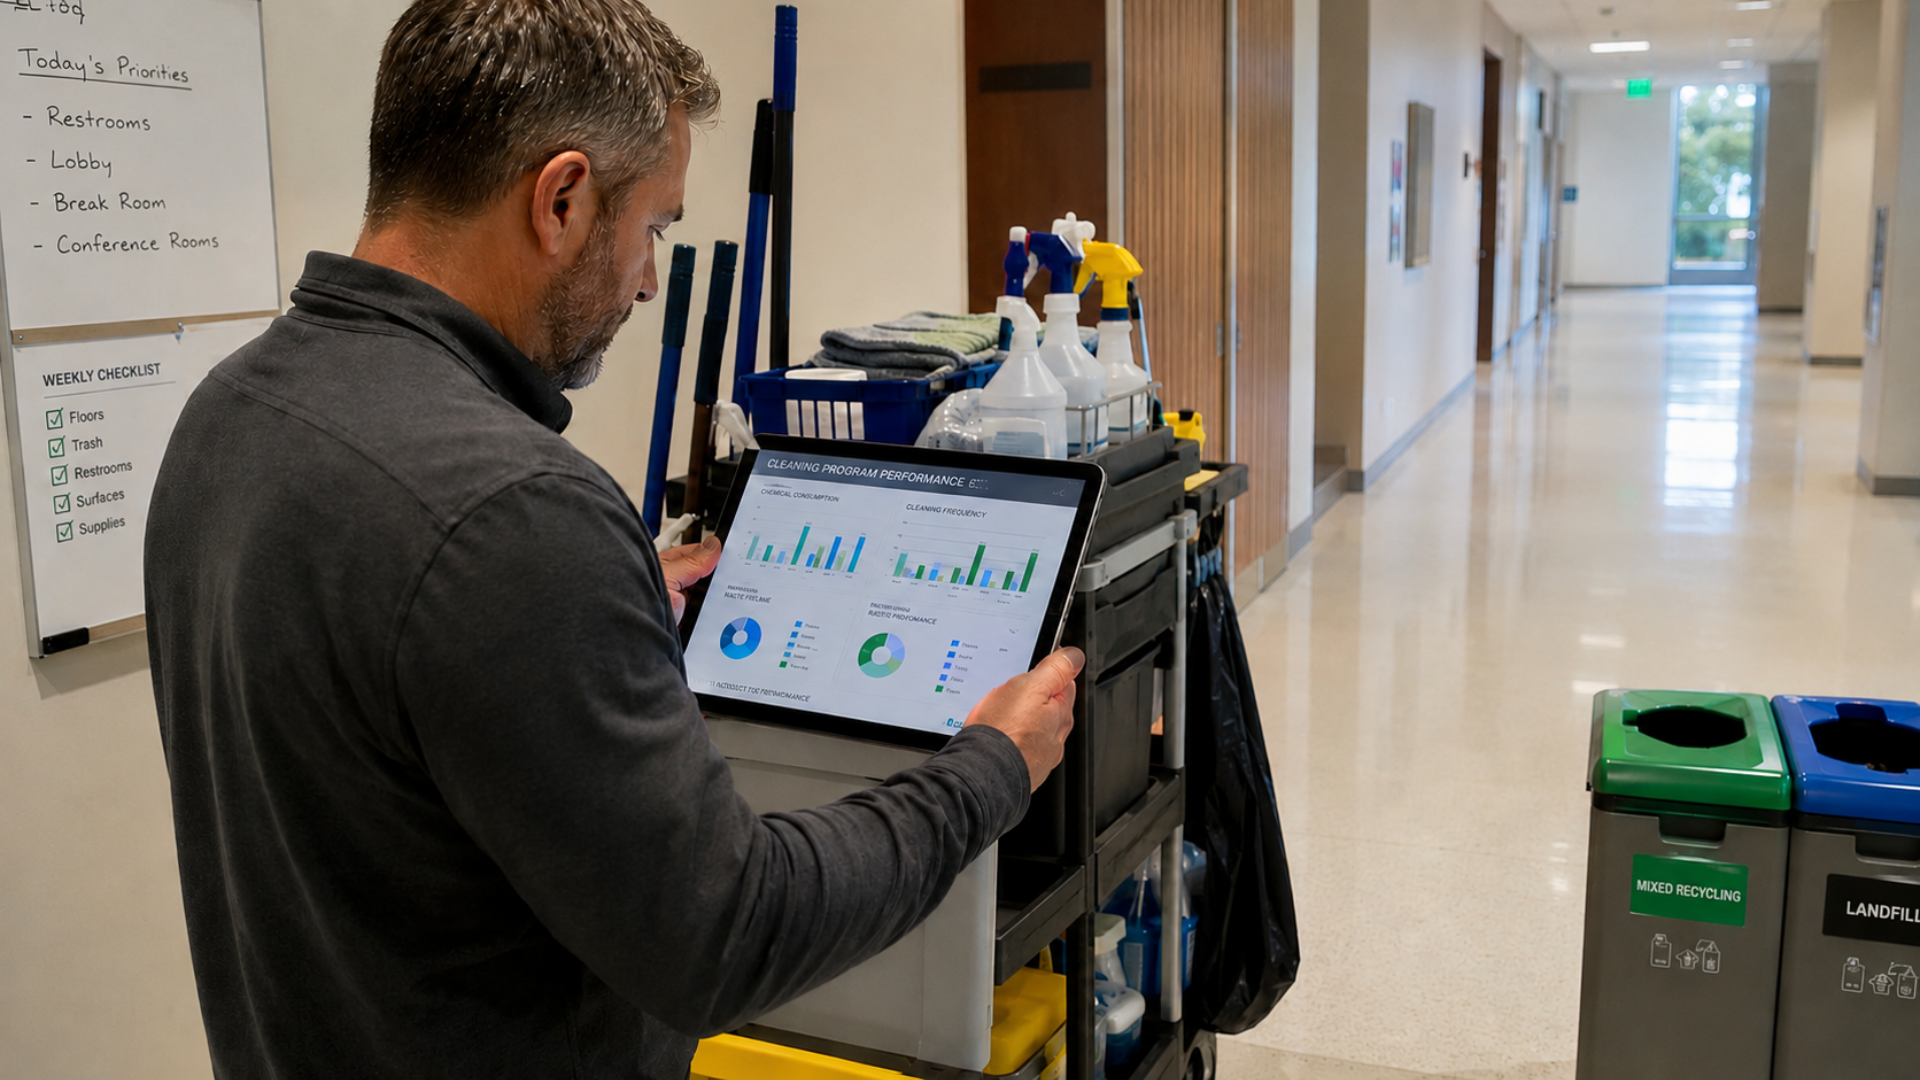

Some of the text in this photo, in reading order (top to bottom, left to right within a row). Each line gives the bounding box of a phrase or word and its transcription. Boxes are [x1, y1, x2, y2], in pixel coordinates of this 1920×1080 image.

[18, 48, 189, 83] Today's Priorities
[47, 105, 150, 131] Restrooms
[51, 150, 111, 178] Lobby
[53, 192, 166, 212] Break Room
[57, 231, 219, 254] Conference Rooms
[43, 363, 161, 387] WEEKLY CHECKLIST
[69, 409, 104, 424] Floors
[72, 436, 103, 452] Trash
[75, 460, 132, 480] Restrooms
[767, 458, 820, 473] CLEANING
[821, 463, 878, 479] PROGRAM
[879, 469, 966, 487] PERFORMANCE
[76, 489, 125, 508] Surfaces
[79, 516, 126, 536] Supplies
[1637, 879, 1742, 903] MIXED RECYCLING
[1846, 901, 1920, 923] LANDFILL
